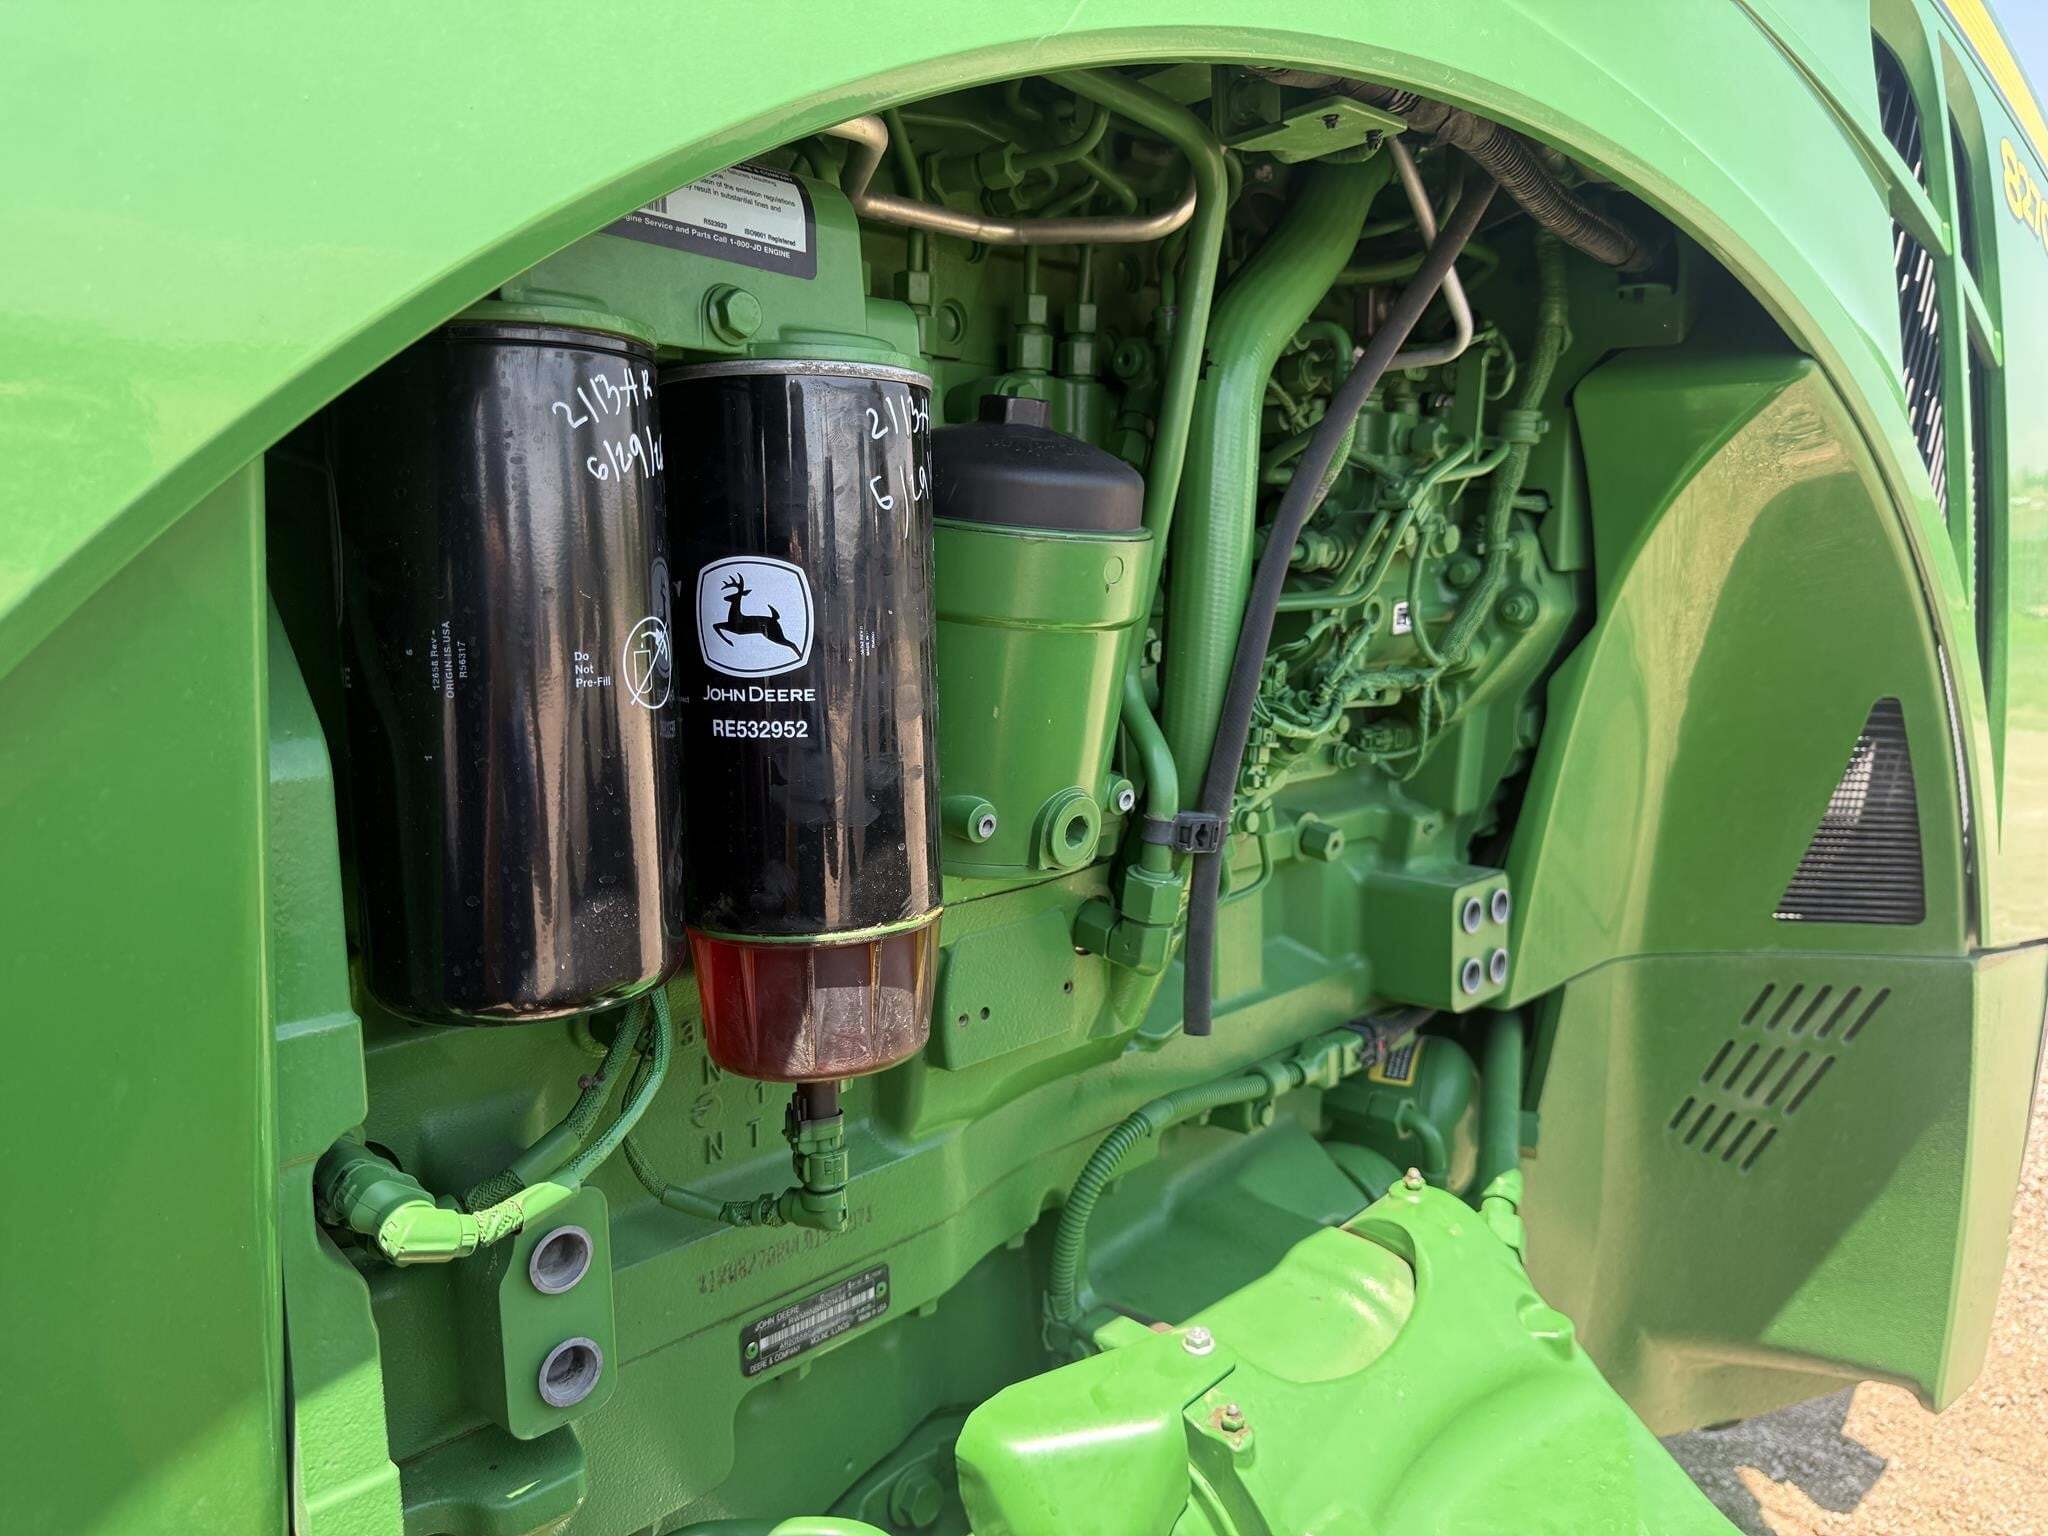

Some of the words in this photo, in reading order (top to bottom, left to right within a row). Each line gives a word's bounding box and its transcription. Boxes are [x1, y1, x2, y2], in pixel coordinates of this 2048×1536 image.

[645, 217, 673, 231] Service
[675, 225, 690, 234] and
[691, 228, 711, 240] Parts
[712, 234, 728, 244] Call
[764, 246, 791, 259] ENGINE
[441, 620, 451, 644] USA
[443, 646, 452, 657] IS
[574, 651, 589, 661] Do
[575, 664, 594, 674] Not
[444, 660, 455, 699] ORIGIN
[575, 676, 611, 688] Pre-Fill
[704, 685, 745, 702] JOHN
[749, 686, 816, 702] DEERE
[712, 719, 809, 738] RE532952
[755, 1316, 775, 1332] JOHN
[776, 1305, 800, 1321] DEERE
